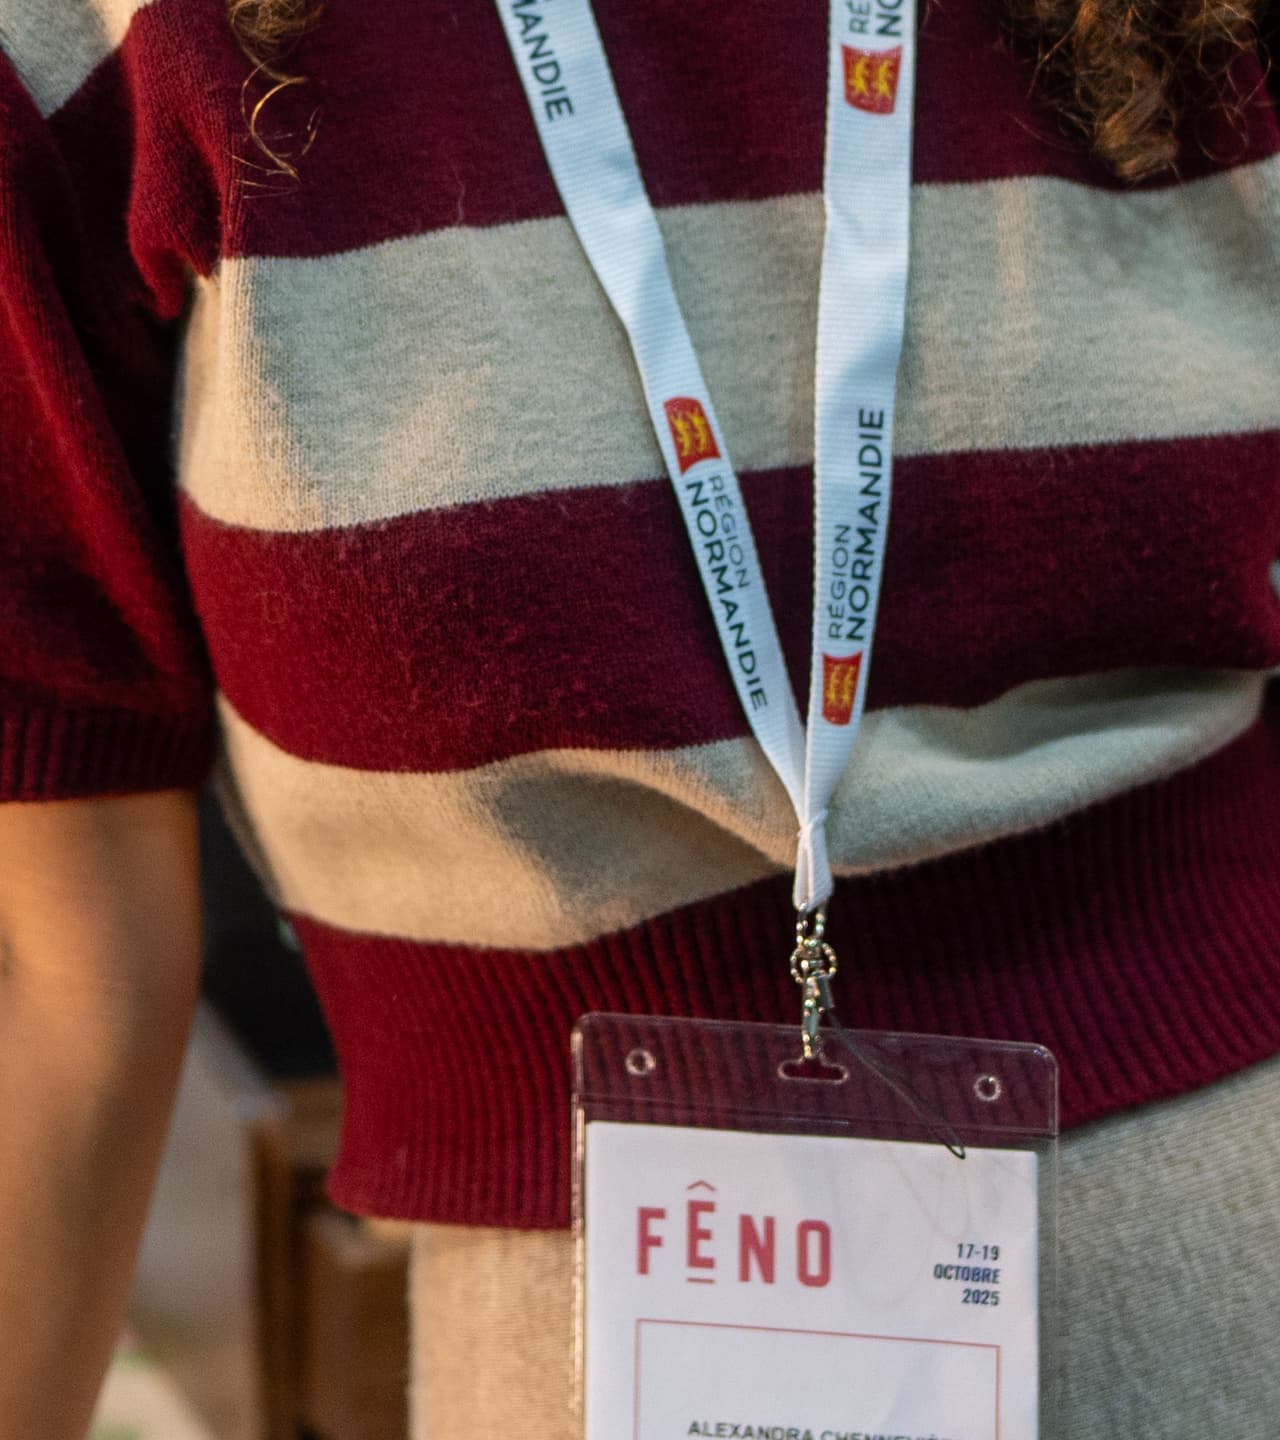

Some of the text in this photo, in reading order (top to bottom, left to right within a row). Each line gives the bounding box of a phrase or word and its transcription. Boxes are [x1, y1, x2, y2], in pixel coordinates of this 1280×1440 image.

[708, 475, 750, 589] RÉGION
[845, 407, 885, 642] NORMANDIE
[686, 481, 768, 711] NORMANDIE
[828, 524, 852, 640] RÉGION
[637, 1180, 831, 1288] FÊNO
[933, 1263, 1002, 1284] OCTOBRE
[957, 1242, 1001, 1261] 17-19
[961, 1288, 1001, 1306] 2025
